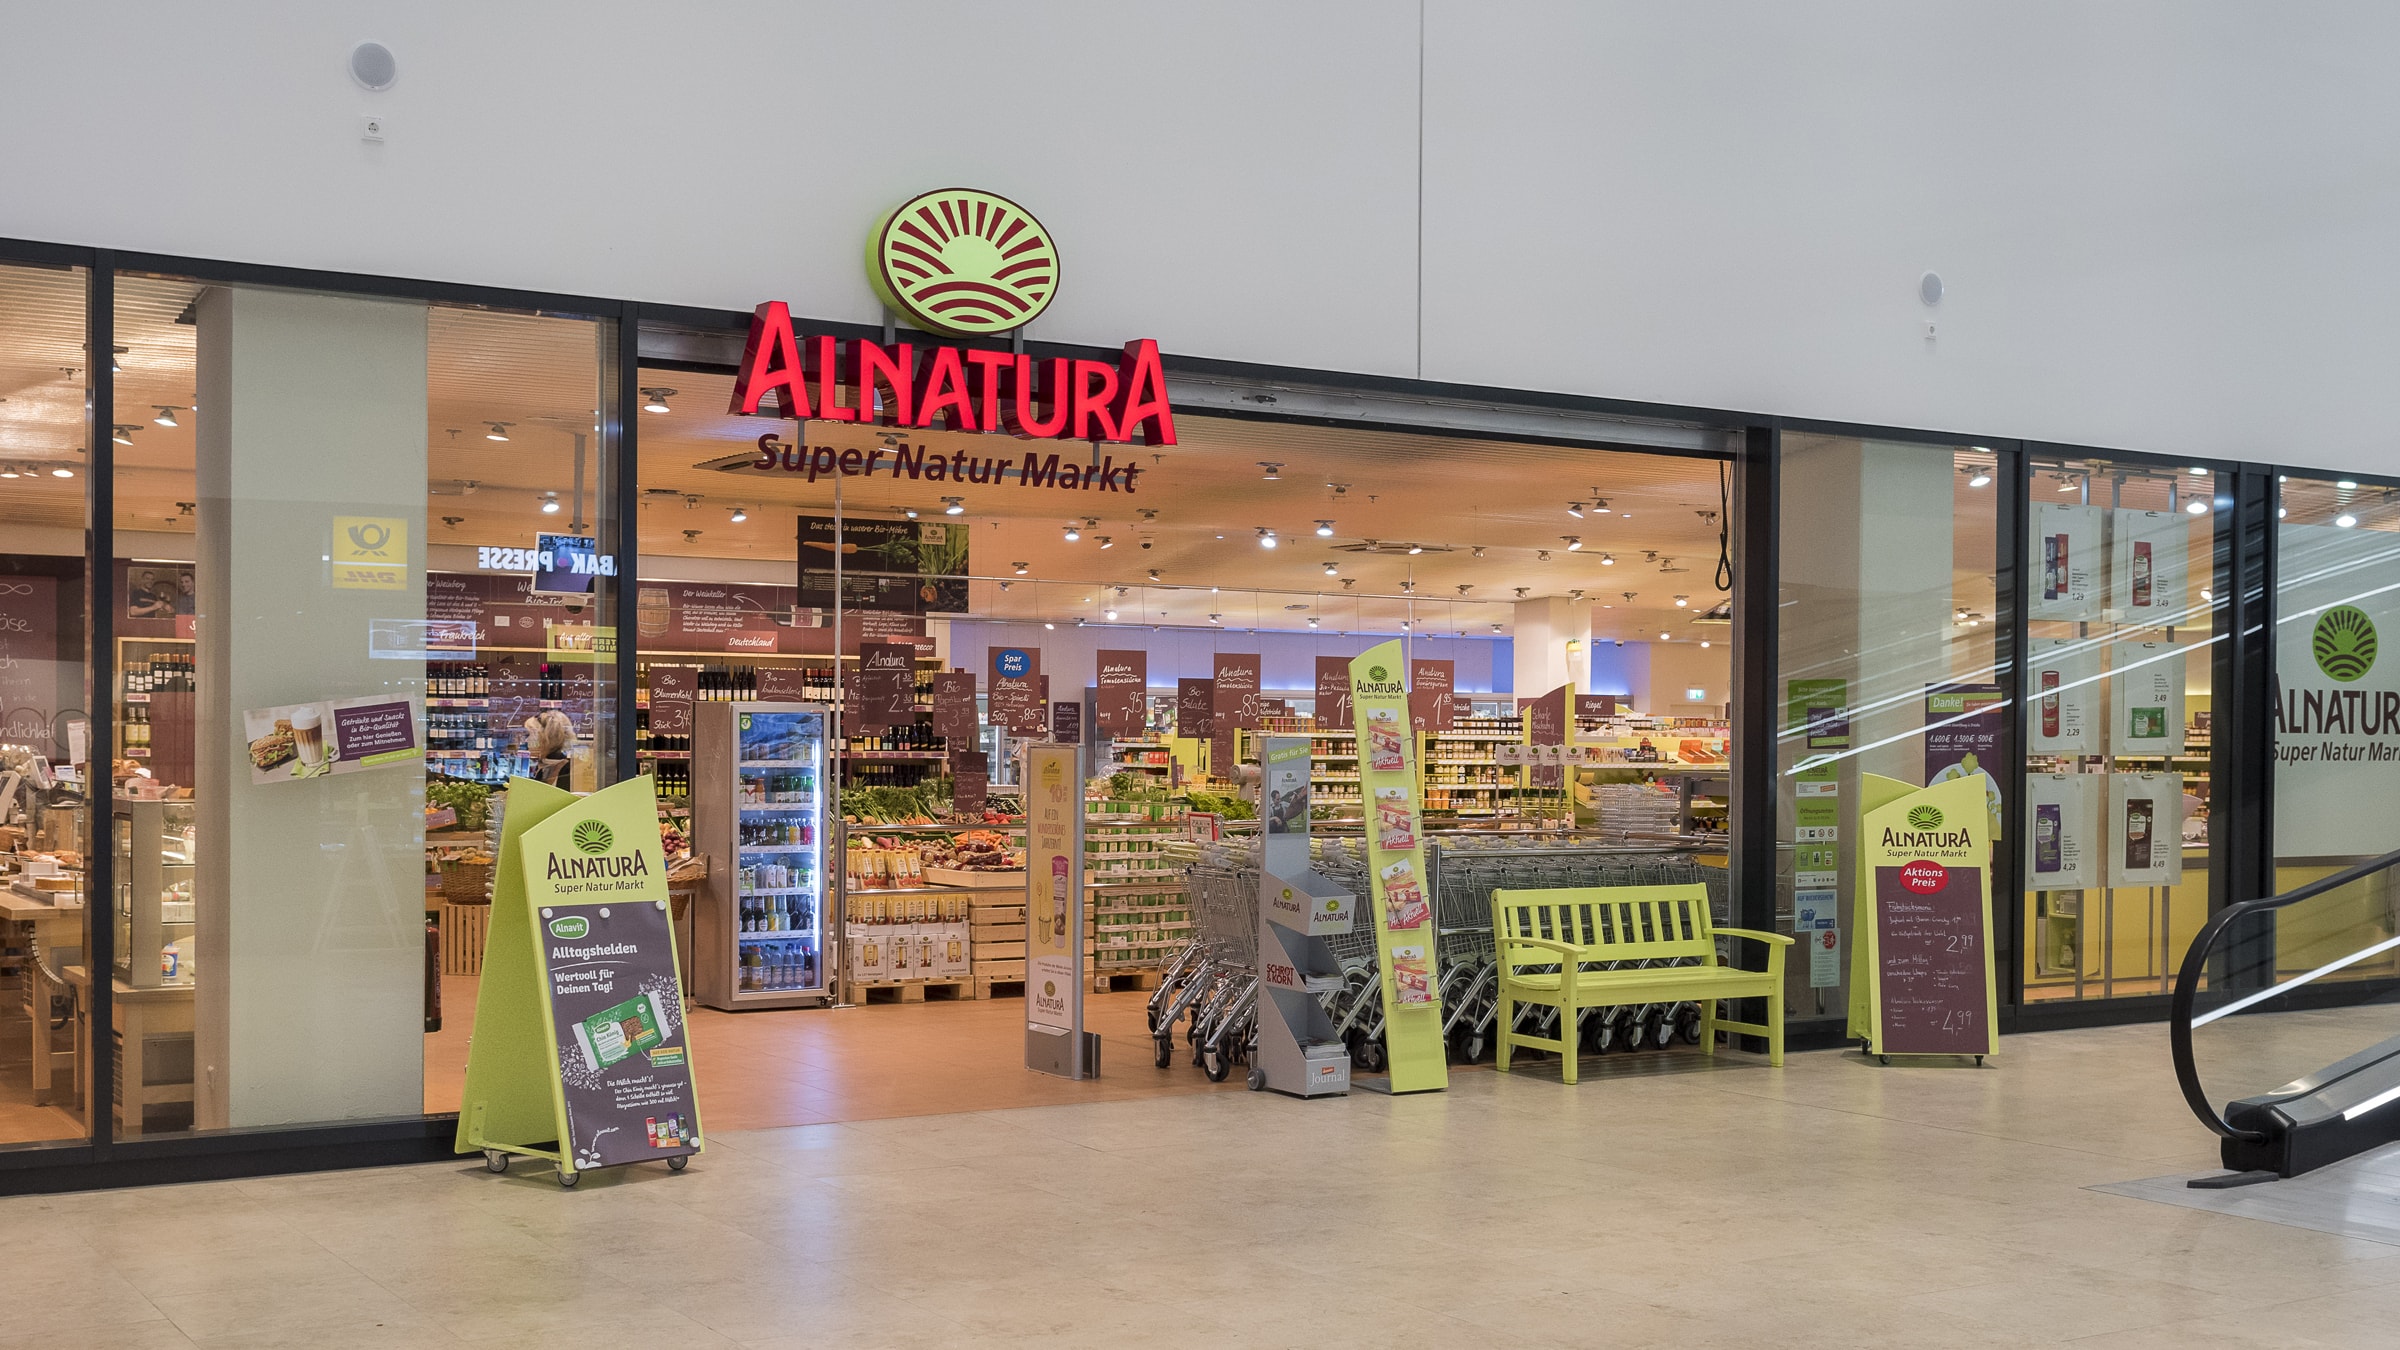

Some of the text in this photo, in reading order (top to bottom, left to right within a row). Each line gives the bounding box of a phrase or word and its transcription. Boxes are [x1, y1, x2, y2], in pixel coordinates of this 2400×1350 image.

[738, 301, 1177, 446] ALNATURA
[754, 433, 1141, 493] Super Natur Markt
[683, 589, 694, 597] Der
[440, 629, 486, 641] Frankreich
[729, 637, 773, 648] Deutschland
[1004, 654, 1022, 664] Spar
[1003, 663, 1022, 671] Preis
[1218, 665, 1253, 678] Alnatura
[1356, 679, 1404, 693] ALNATURA
[1933, 696, 1964, 708] Danke!
[2154, 694, 2167, 702] 3,49
[1584, 700, 1603, 712] Riegel
[2066, 728, 2080, 737] 2,29
[374, 736, 407, 746] Mitnehmen
[1270, 752, 1288, 761] Gratis
[1299, 746, 1309, 754] Sie
[2273, 741, 2400, 767] Super Natur Mar
[1375, 754, 1399, 768] Aktuell
[1882, 827, 1972, 848] ALNATURA
[1887, 849, 1967, 858] Super Natur Markt
[547, 849, 648, 880] ALNATURA
[2063, 863, 2076, 872] 4,29
[1904, 868, 1943, 877] Aktions
[554, 879, 644, 895] Super Natur Markt
[1911, 878, 1936, 887] Preis
[1273, 897, 1301, 914] ALNATURA
[1313, 910, 1349, 923] ALNATURA
[555, 922, 584, 933] Alnavit
[552, 942, 638, 961] Alltagshelden
[555, 969, 615, 983] Wertvoll für
[1266, 963, 1294, 978] SCHROT
[1271, 972, 1294, 986] KORN
[556, 981, 614, 995] Deinen Tag!
[1036, 993, 1065, 1011] ALNATURA
[1310, 1069, 1345, 1087] Journal
